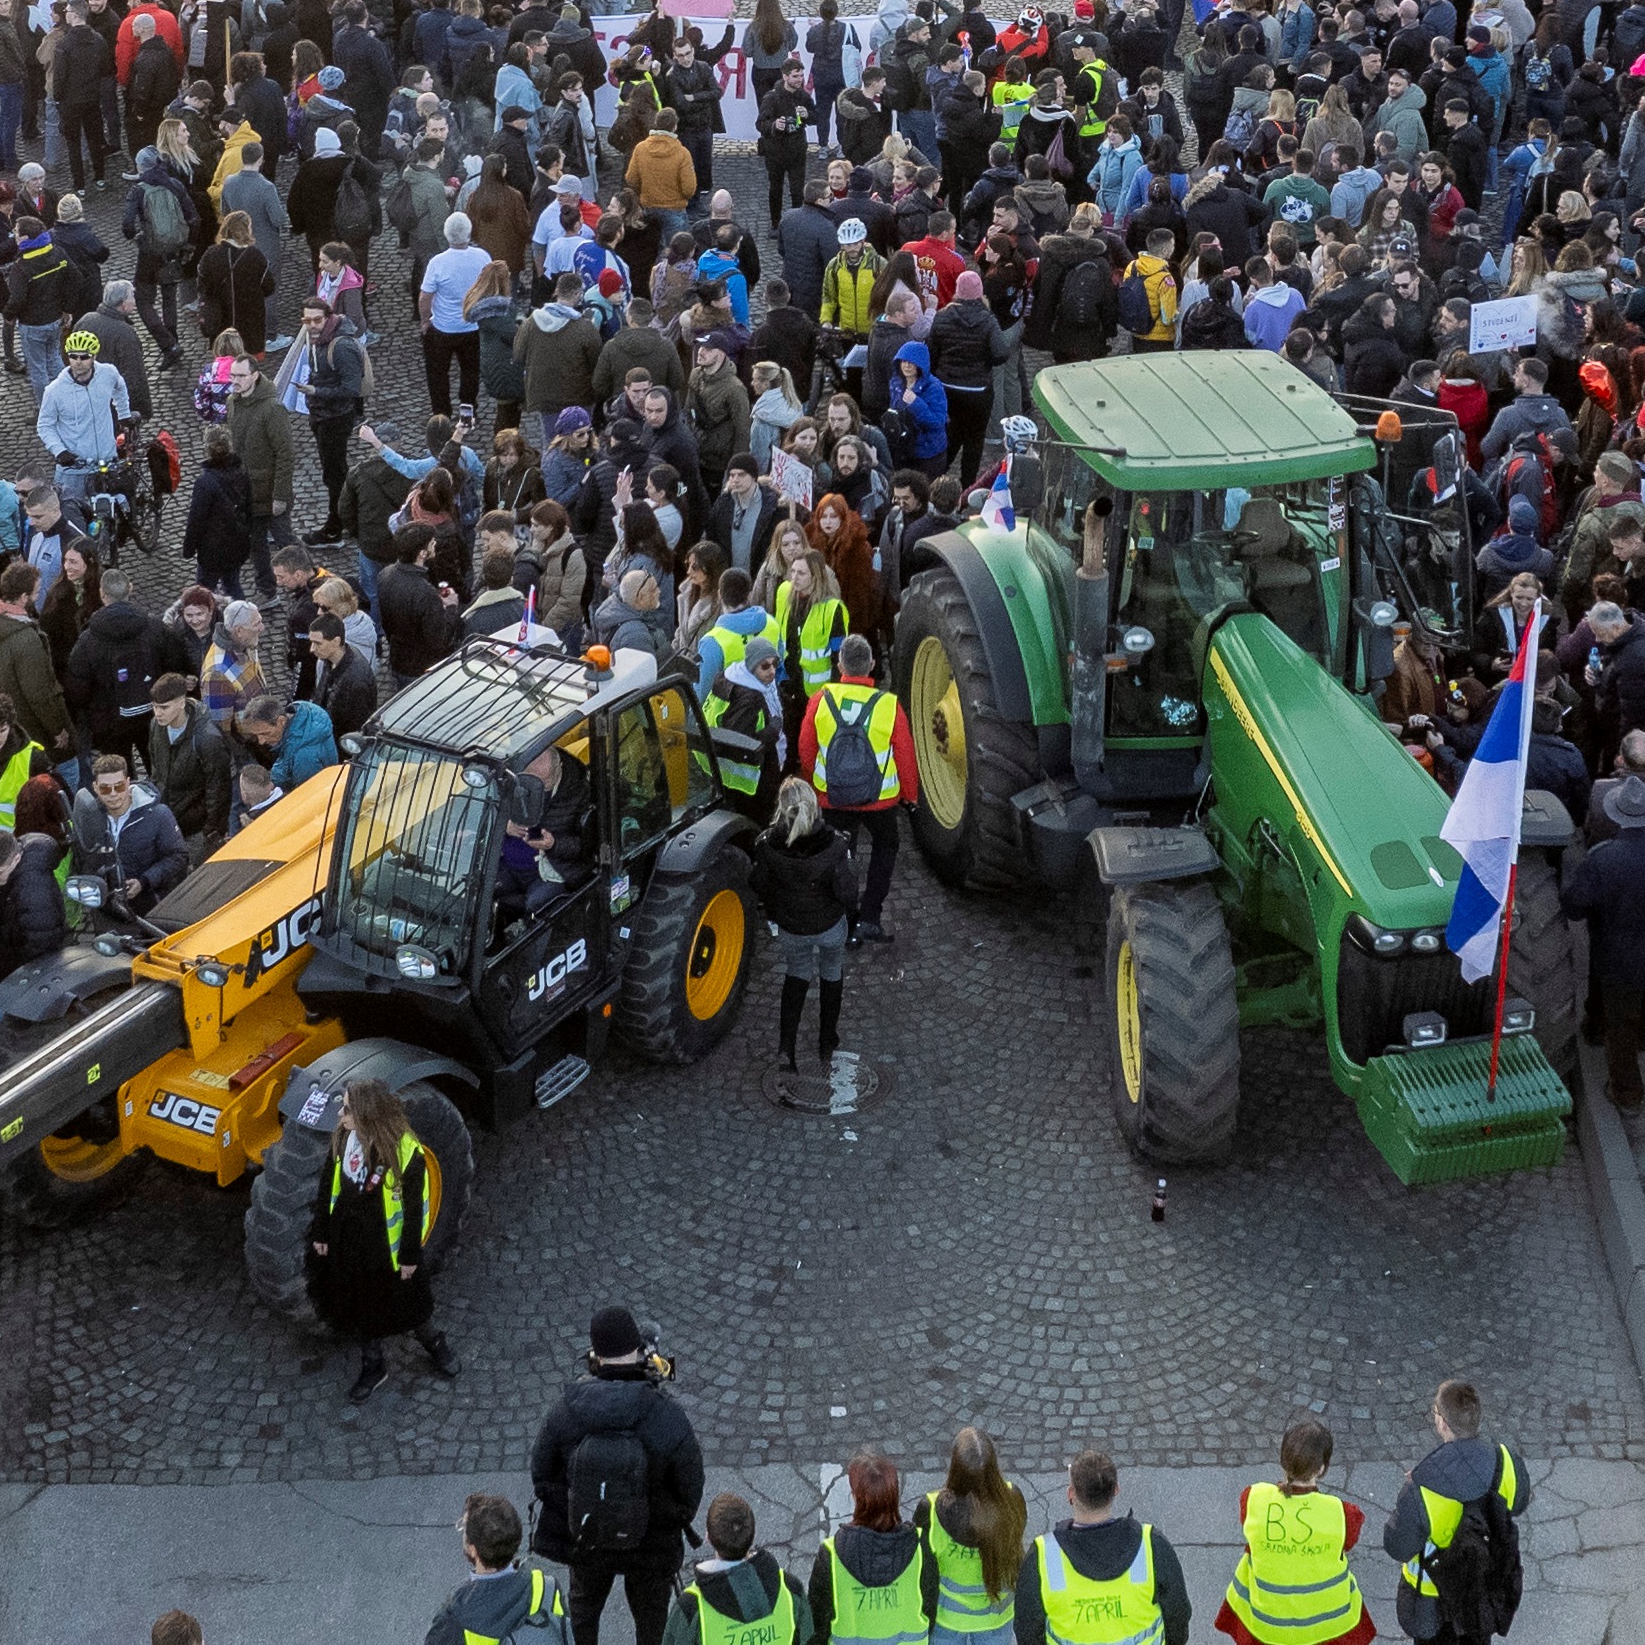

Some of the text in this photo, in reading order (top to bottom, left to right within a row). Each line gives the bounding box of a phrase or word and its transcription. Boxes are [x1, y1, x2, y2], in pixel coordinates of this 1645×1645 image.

[261, 899, 322, 968] JC
[528, 938, 587, 1001] JCB
[150, 1094, 219, 1135] JCB
[854, 1588, 900, 1611] 7 APRIL
[1071, 1600, 1128, 1624] 7 APRIL
[740, 1625, 780, 1645] APRIL
